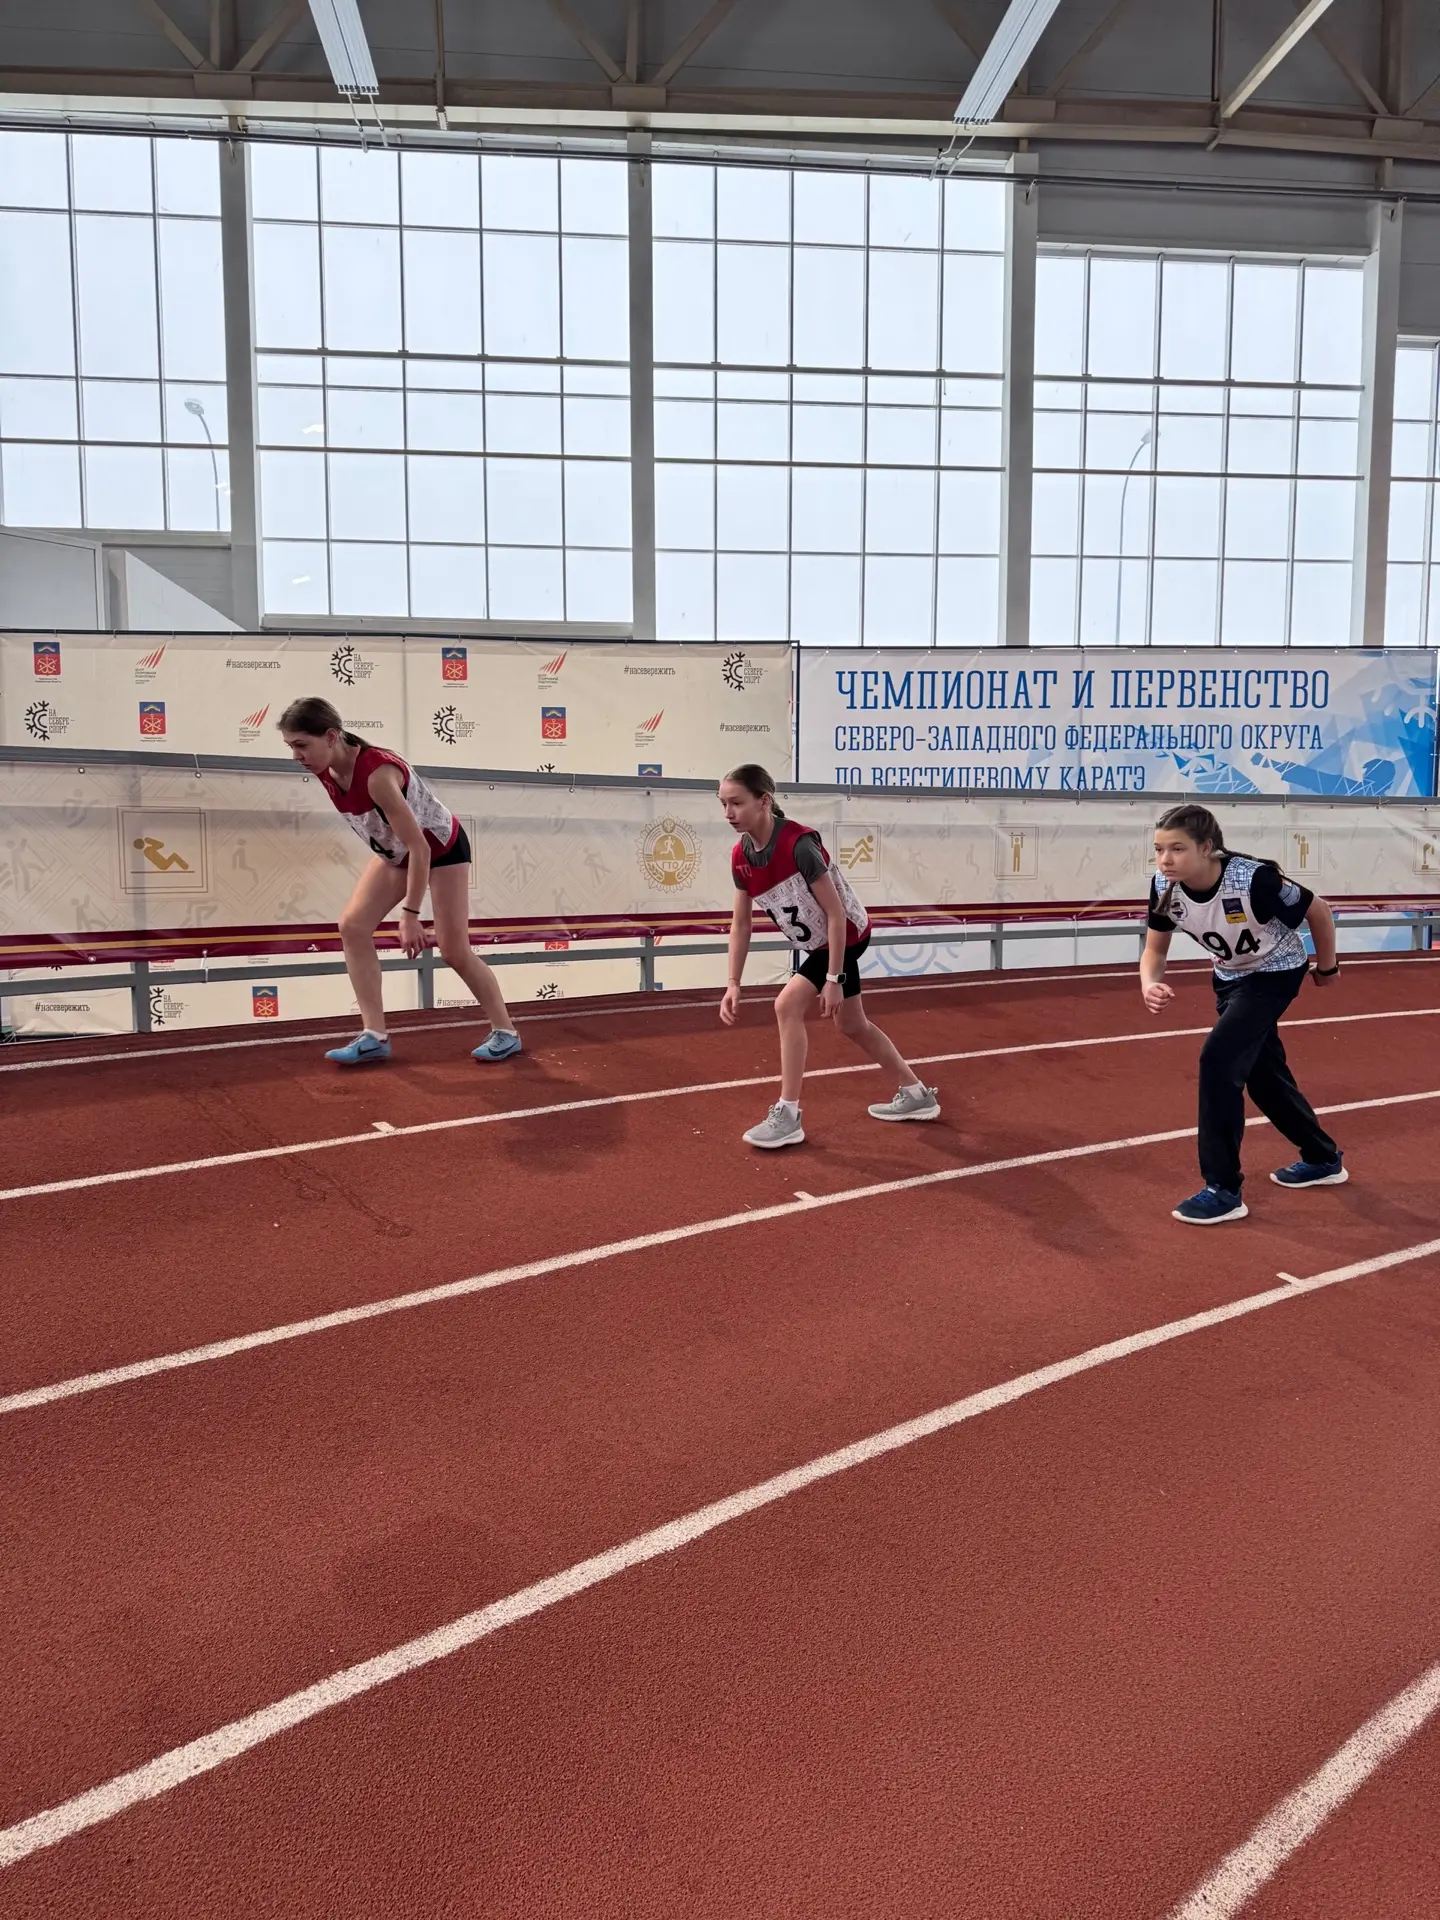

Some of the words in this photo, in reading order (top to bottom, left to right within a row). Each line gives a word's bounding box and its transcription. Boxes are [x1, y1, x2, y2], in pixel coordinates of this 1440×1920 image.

[225, 658, 281, 670] #насевережить
[623, 665, 676, 676] #насевережить
[835, 670, 1058, 710] ЧЕМПИОНАТ
[1071, 670, 1095, 709] И
[1110, 670, 1330, 709] ПЕРВЕНСТВО
[343, 720, 384, 731] севережить
[719, 722, 771, 733] #насевережить
[834, 725, 1057, 753] СЕВЕРО-ЗАПАДНОГО
[1065, 724, 1233, 753] ФЕДЕРАЛЬНОГО
[1241, 724, 1324, 750] ОКРУГА
[835, 766, 862, 785] ПО
[1059, 765, 1146, 791] КАРАТЭ
[662, 861, 679, 870] ГТО
[766, 906, 811, 942] 3
[1181, 928, 1262, 960] 94
[35, 1002, 91, 1013] #насевережить
